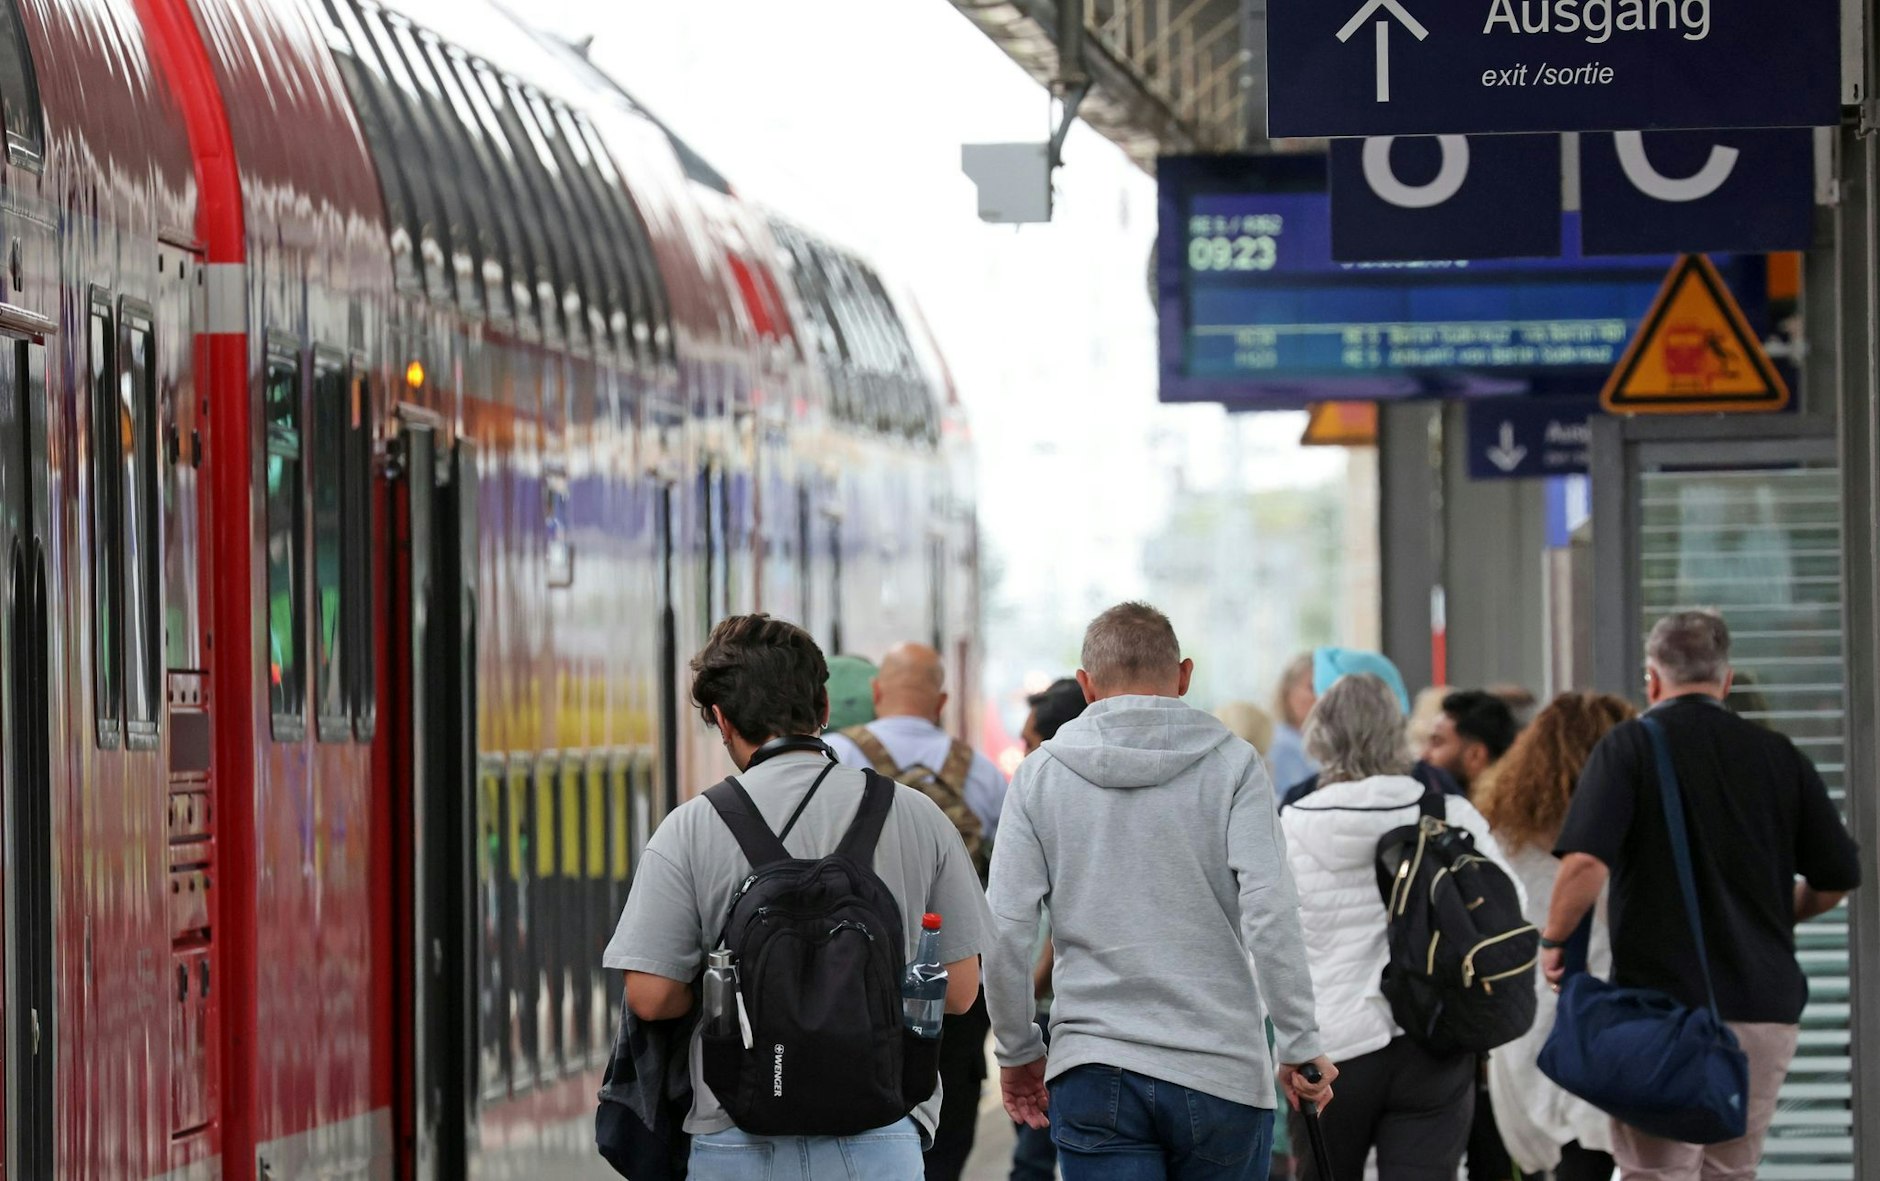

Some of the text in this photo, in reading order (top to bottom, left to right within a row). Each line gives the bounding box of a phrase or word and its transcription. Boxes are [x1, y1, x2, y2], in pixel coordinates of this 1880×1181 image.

[1482, 0, 1711, 44] Ausgang
[1481, 61, 1615, 87] exit /sortie
[773, 1054, 783, 1097] WENGER
